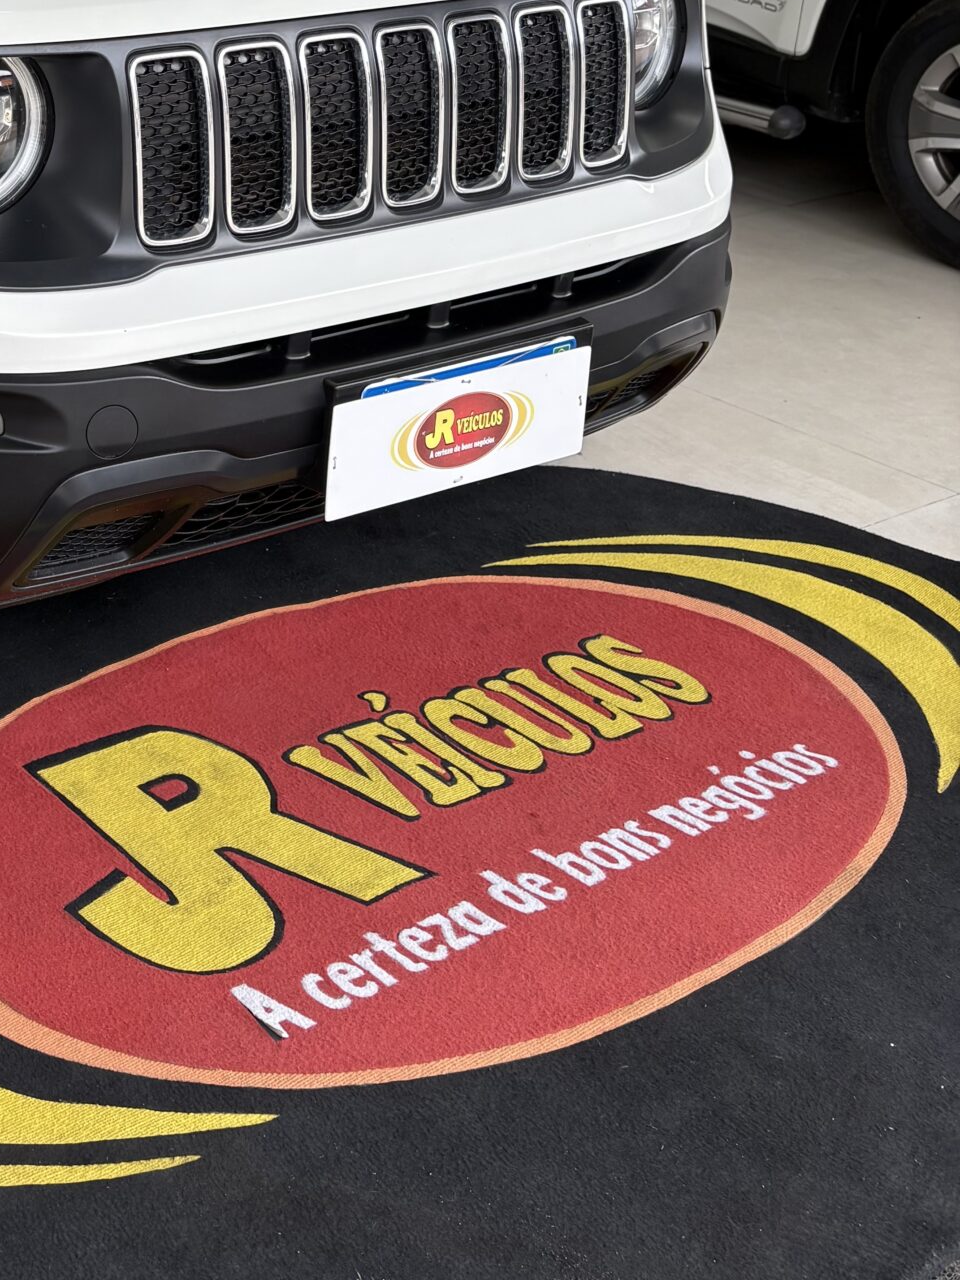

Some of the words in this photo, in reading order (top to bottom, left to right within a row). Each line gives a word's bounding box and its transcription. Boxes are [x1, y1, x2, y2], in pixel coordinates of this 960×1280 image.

[425, 408, 455, 449] JR
[457, 409, 504, 434] VEÍCULOS
[27, 726, 436, 975] JR
[230, 983, 317, 1038] A
[300, 900, 507, 1010] certeza
[479, 869, 568, 914] de
[530, 819, 672, 887] bons
[647, 743, 839, 837] negócios
